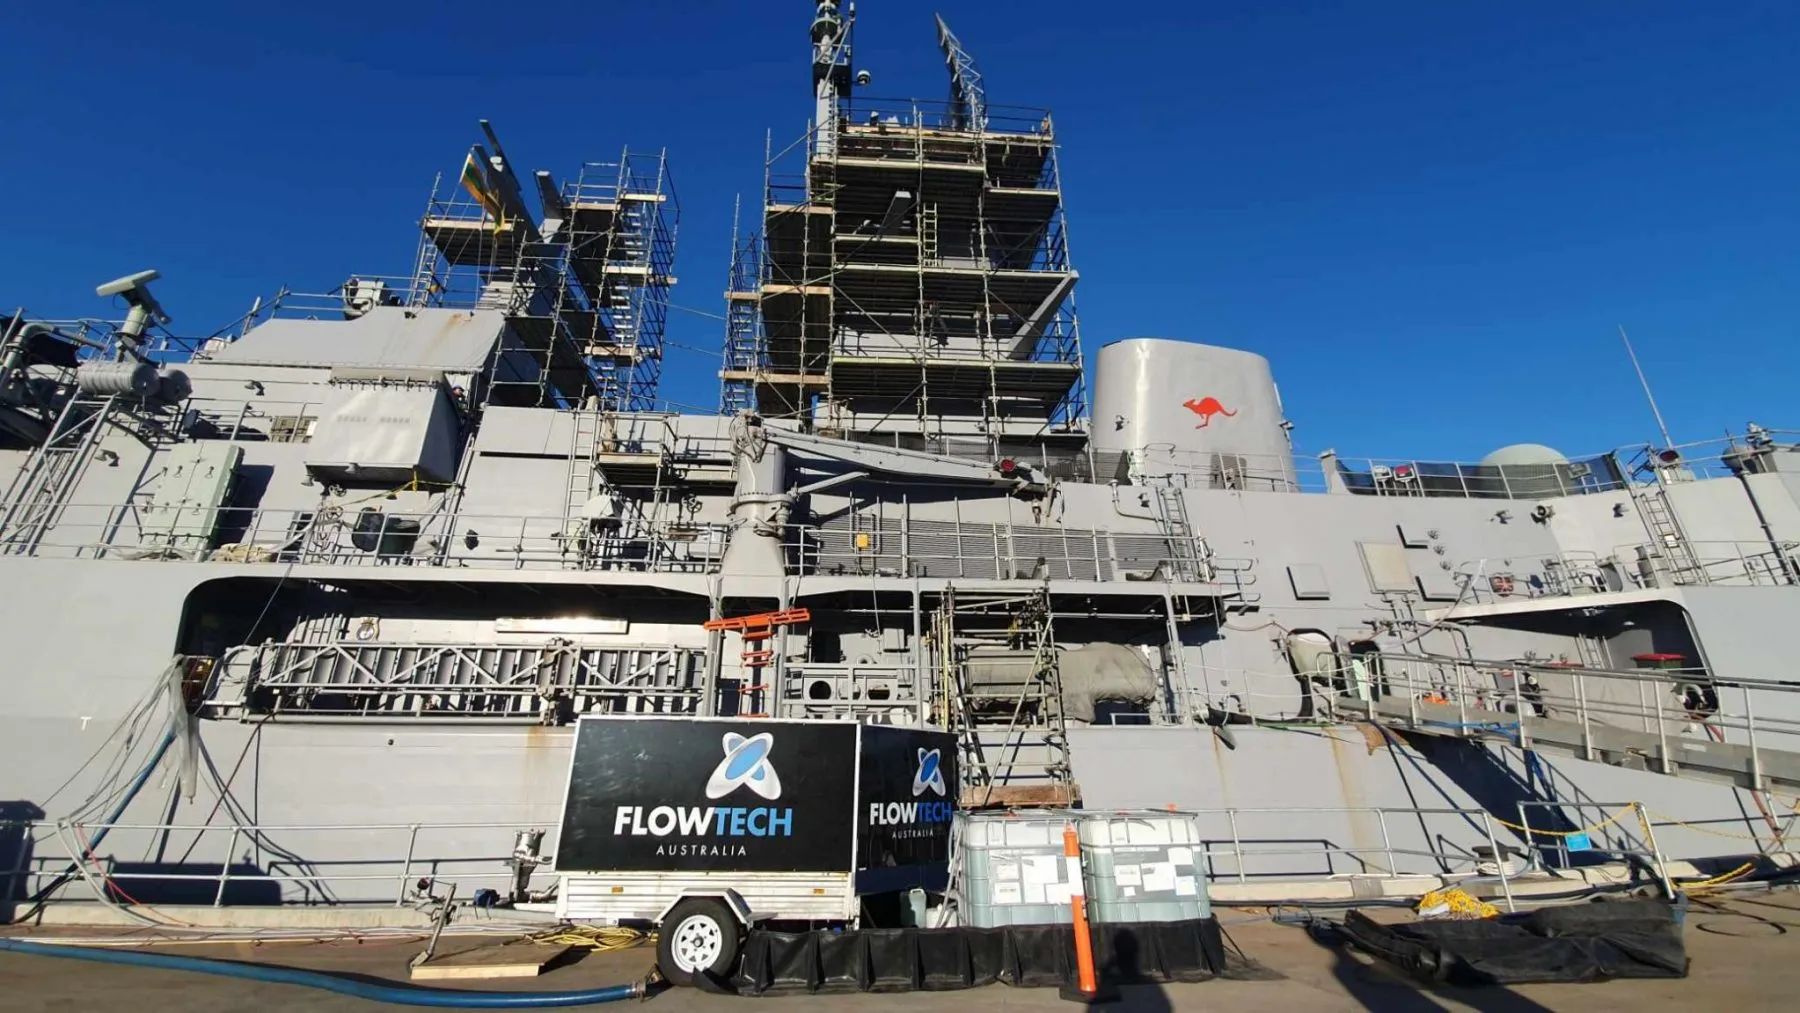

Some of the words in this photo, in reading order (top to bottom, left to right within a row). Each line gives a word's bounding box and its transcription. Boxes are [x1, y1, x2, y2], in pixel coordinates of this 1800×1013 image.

[613, 805, 793, 836] FLOWTECH
[869, 802, 953, 825] FLOWTECH
[892, 828, 934, 839] AUSTRALIA
[655, 844, 747, 857] AUSTRALIA
